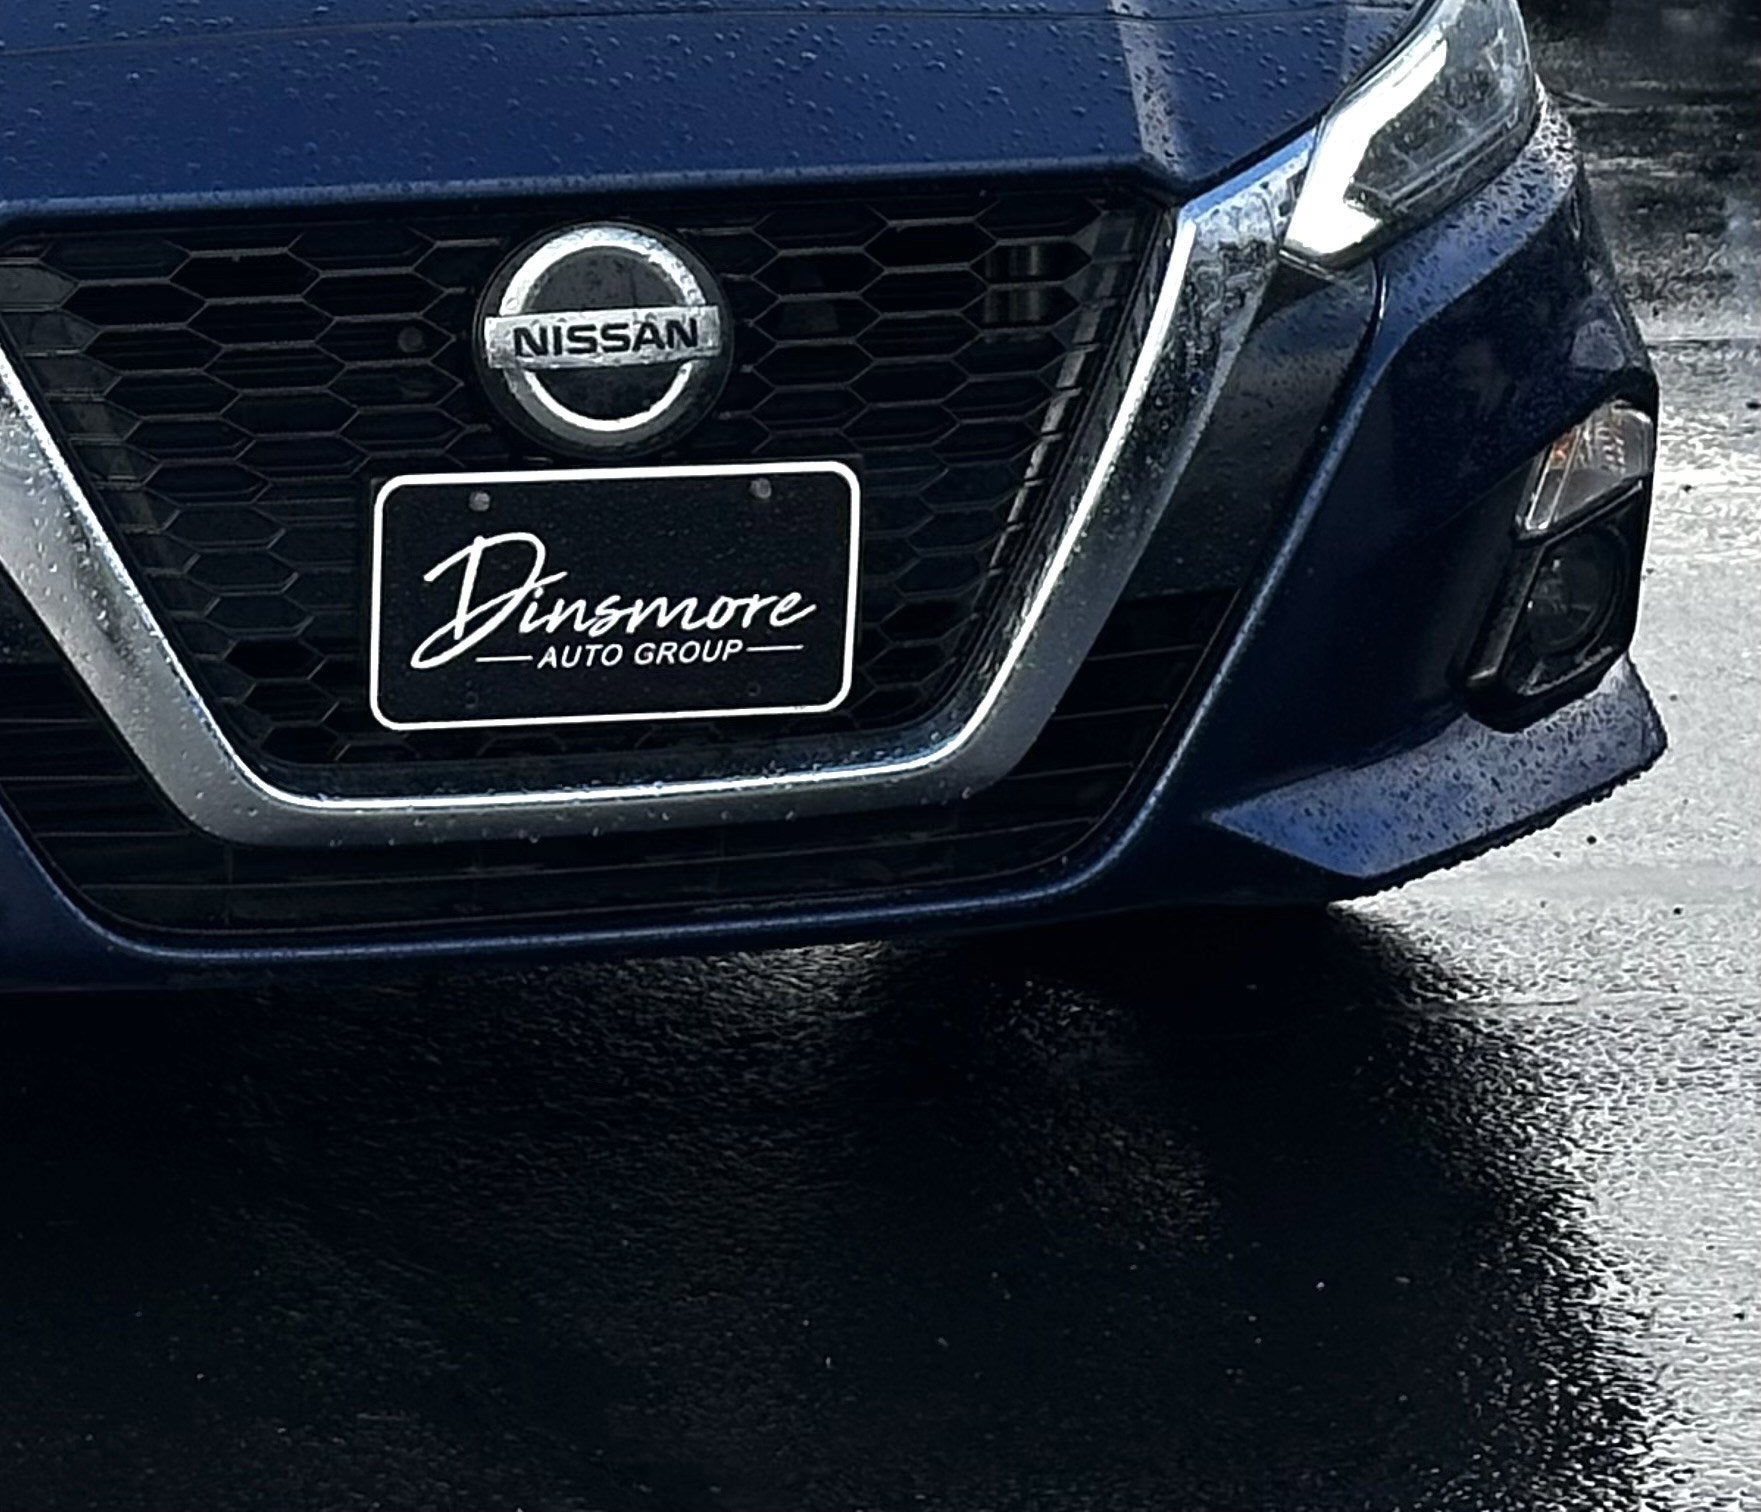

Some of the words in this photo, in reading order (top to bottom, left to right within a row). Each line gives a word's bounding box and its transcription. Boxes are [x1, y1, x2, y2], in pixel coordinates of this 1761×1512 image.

[513, 318, 699, 356] NISSAN
[410, 531, 817, 670] Dinsmore
[537, 643, 624, 669] AUTO
[633, 639, 744, 666] GROUP
